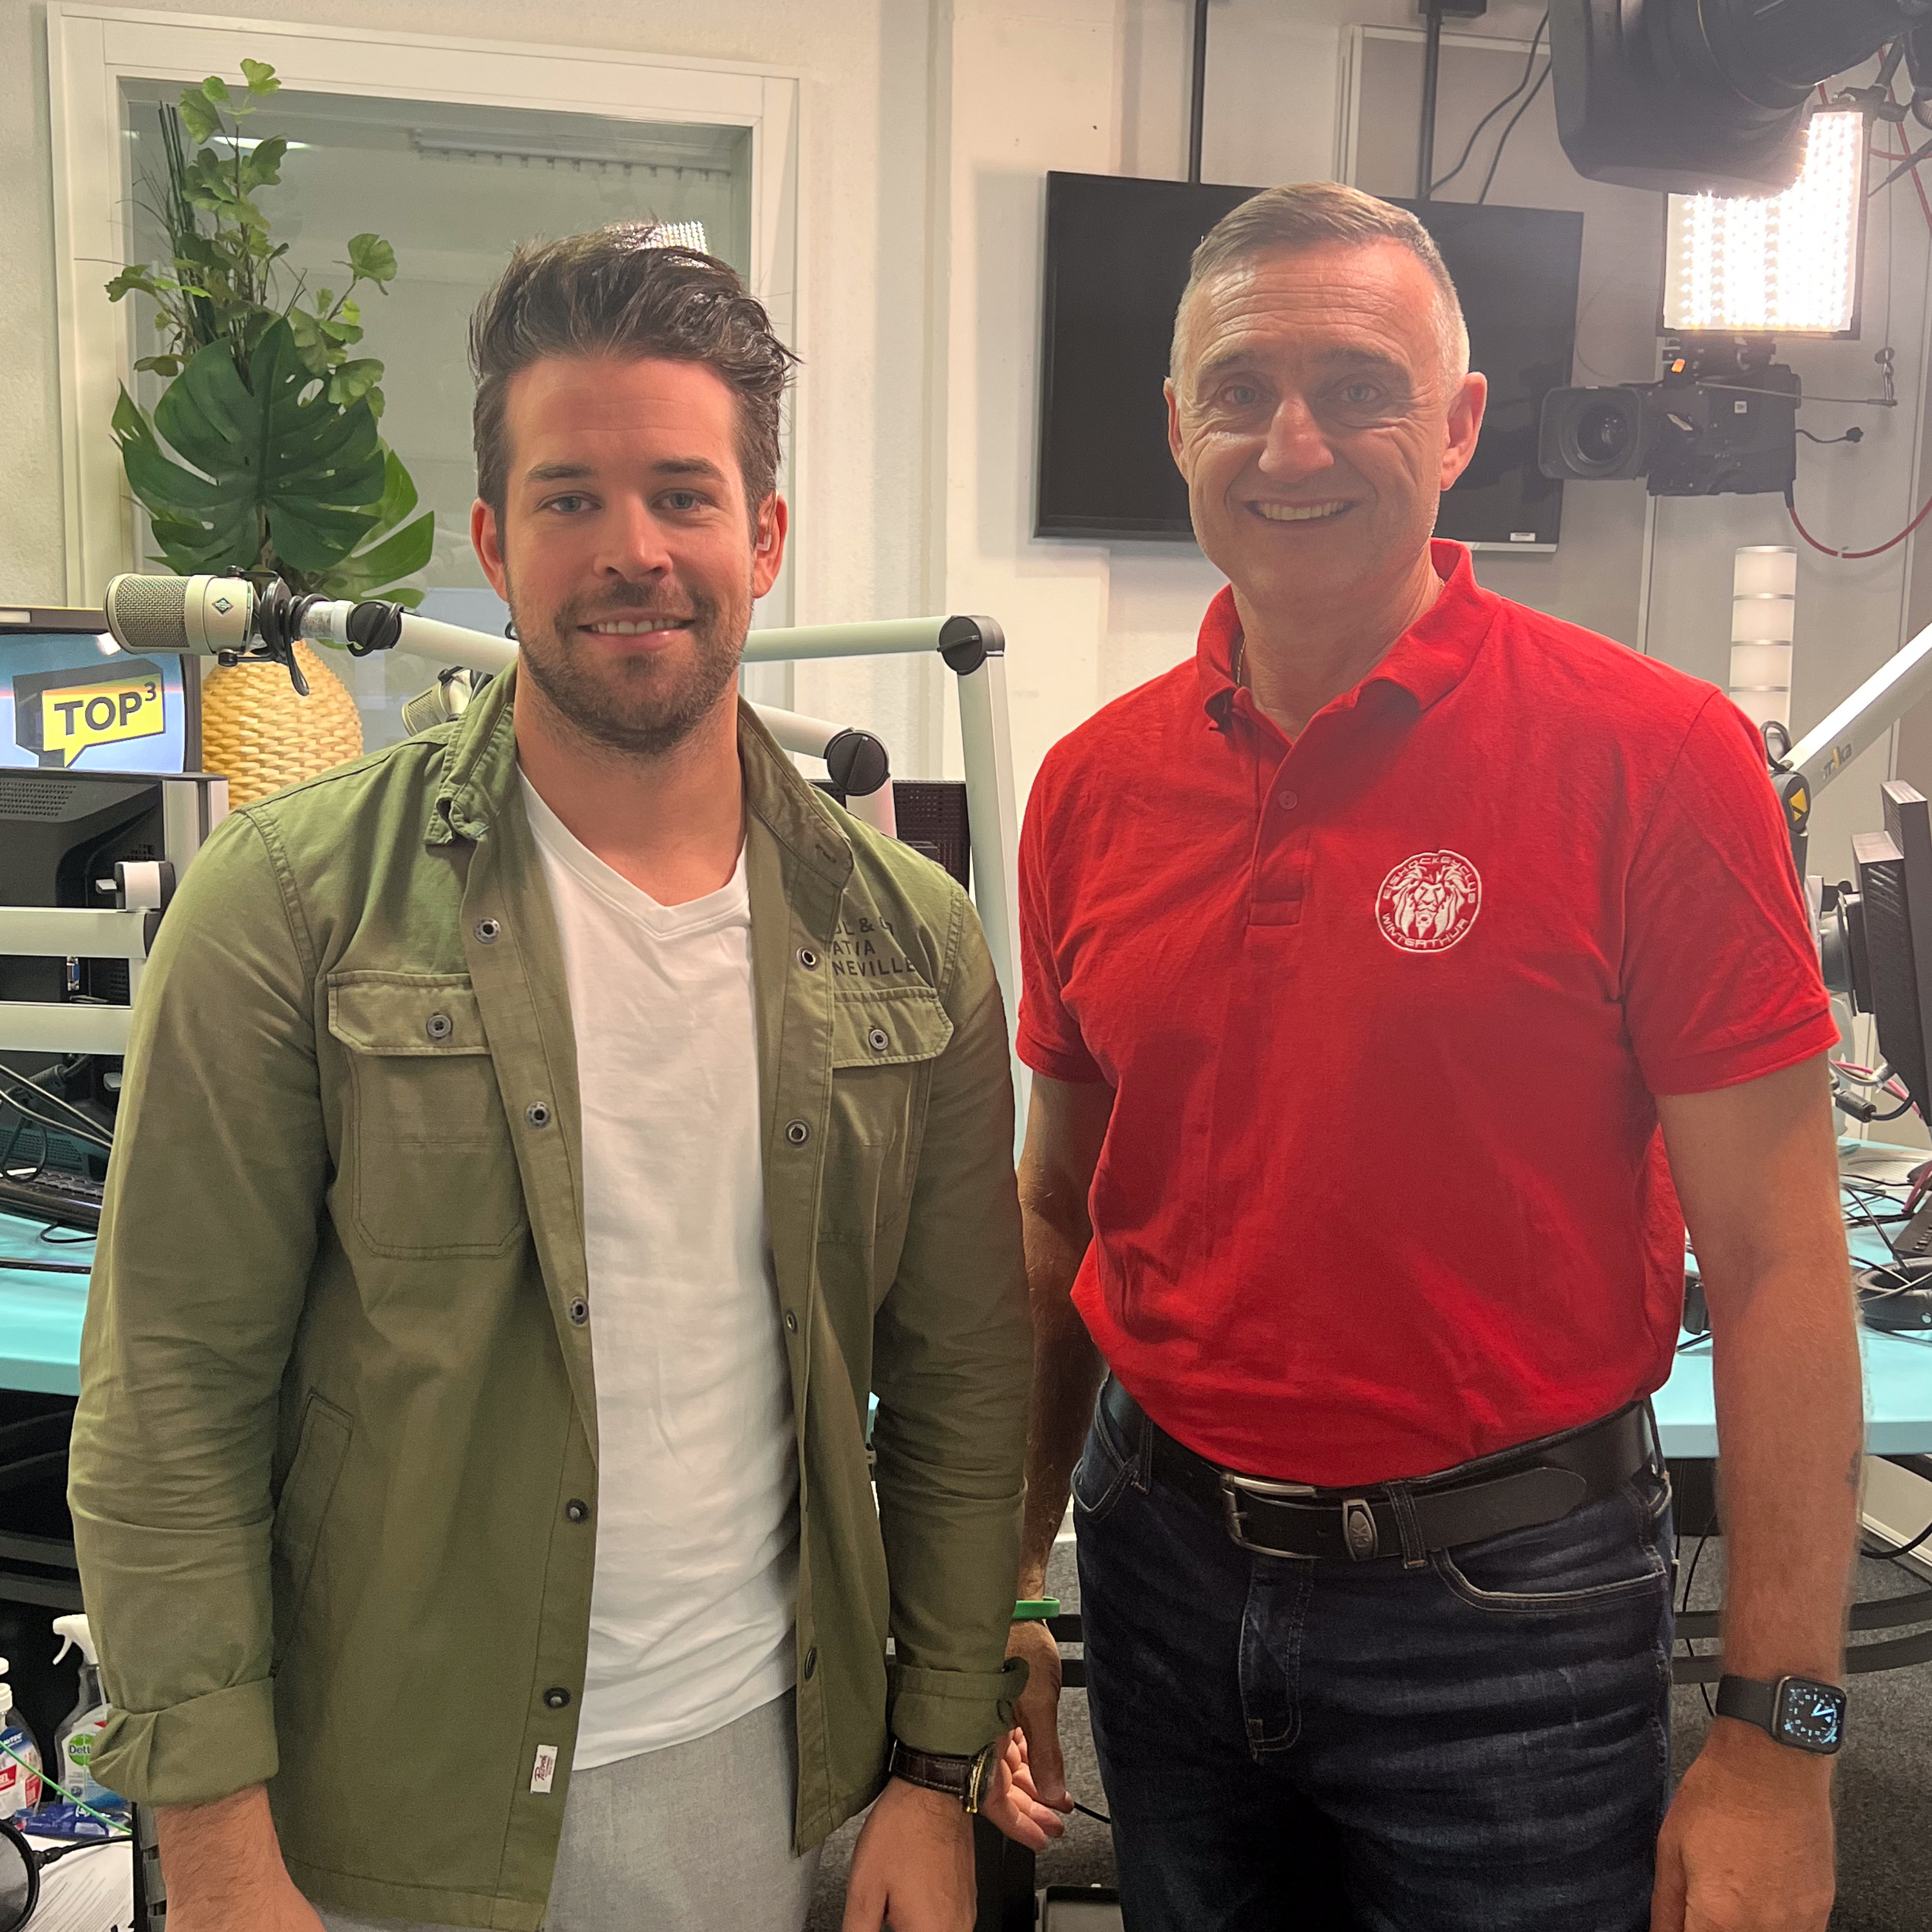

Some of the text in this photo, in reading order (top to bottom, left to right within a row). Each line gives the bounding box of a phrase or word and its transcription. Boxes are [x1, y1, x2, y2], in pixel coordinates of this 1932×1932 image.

[858, 917, 875, 933] &
[833, 940, 876, 956] ATIA
[69, 1745, 90, 1754] Dett
